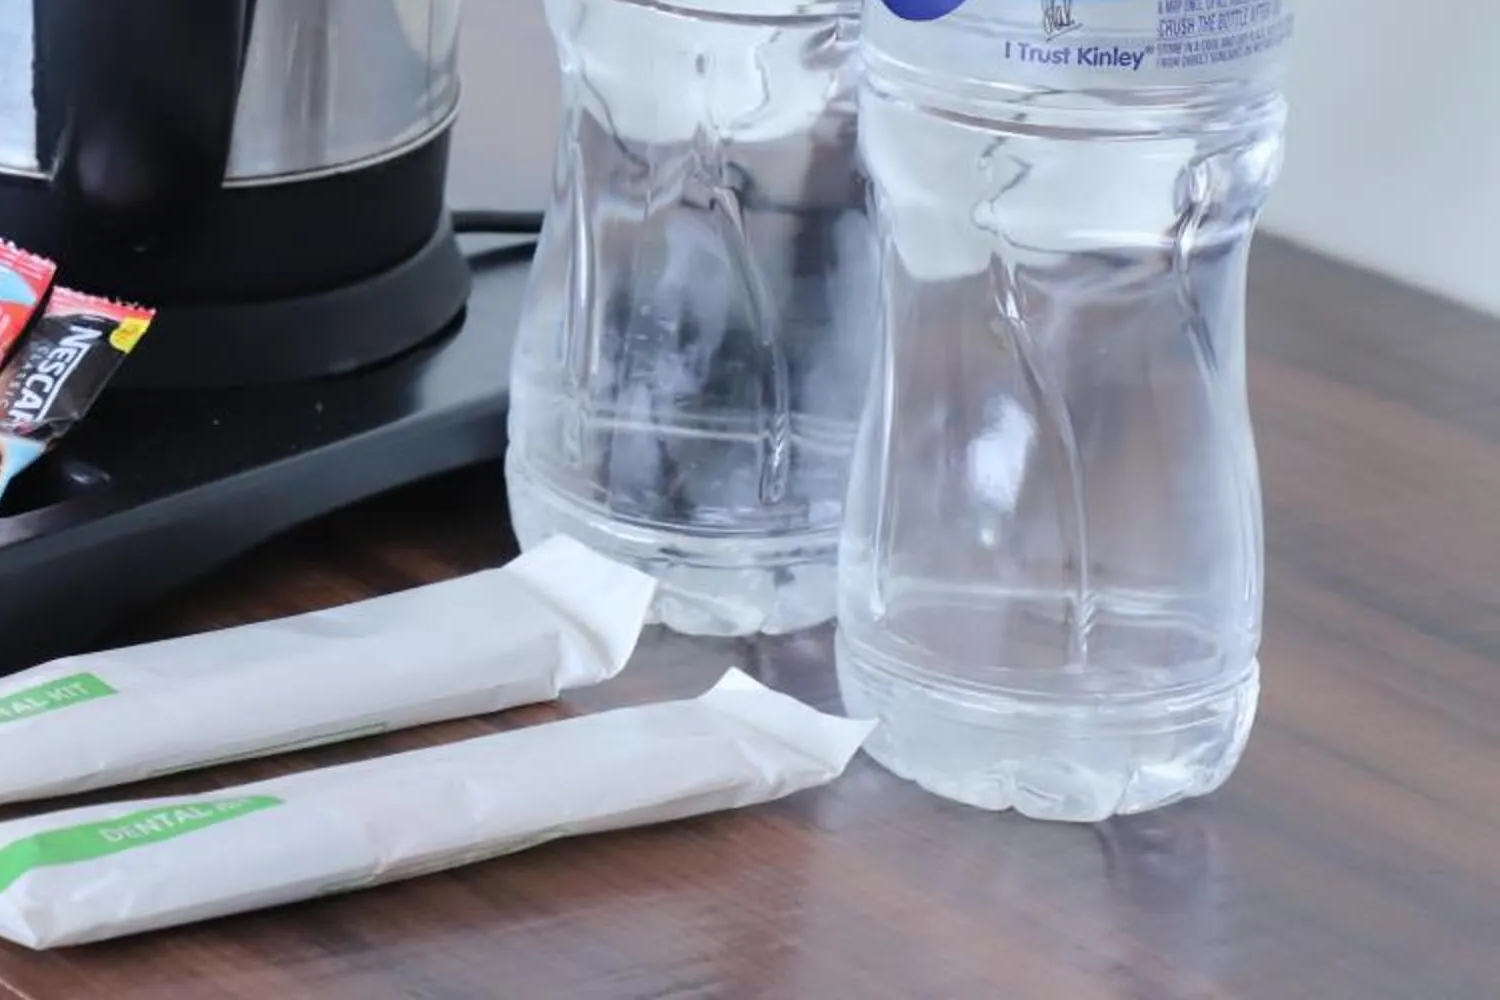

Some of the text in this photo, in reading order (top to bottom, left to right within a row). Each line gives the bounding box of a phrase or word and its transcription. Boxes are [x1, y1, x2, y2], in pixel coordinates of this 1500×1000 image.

[1005, 41, 1011, 58] I
[1017, 42, 1070, 64] Trust
[100, 805, 214, 842] DENTAL
